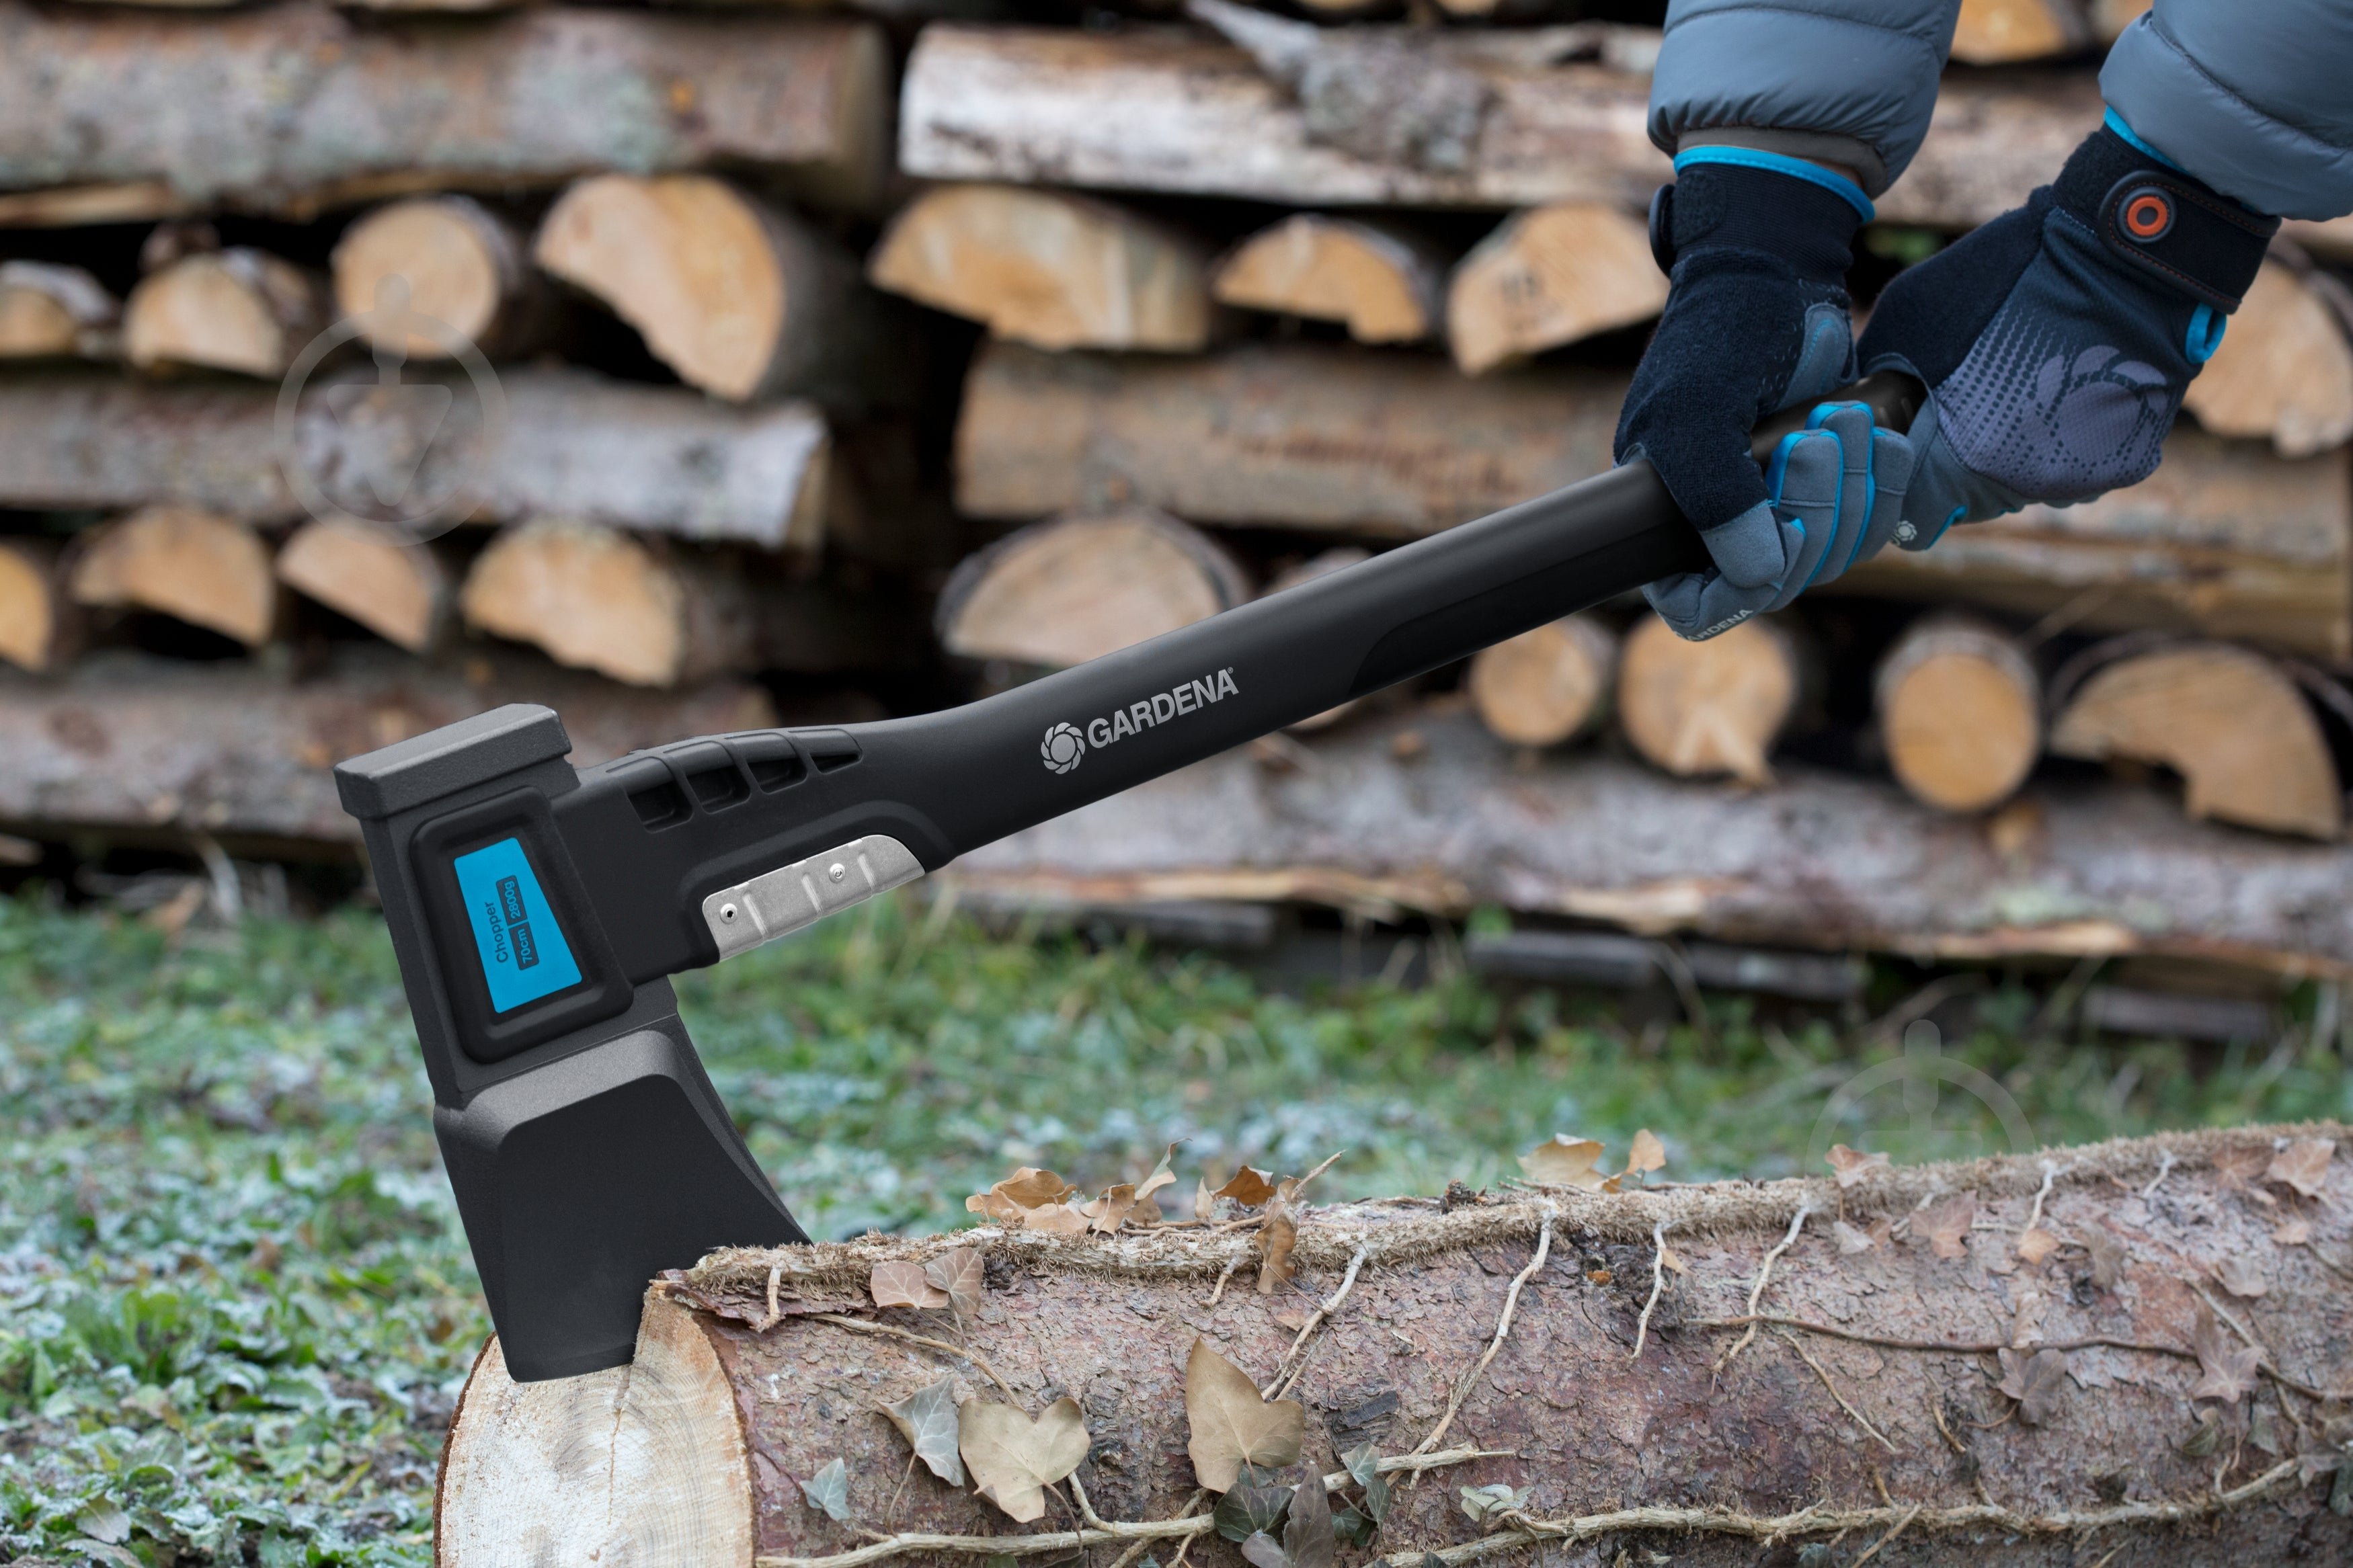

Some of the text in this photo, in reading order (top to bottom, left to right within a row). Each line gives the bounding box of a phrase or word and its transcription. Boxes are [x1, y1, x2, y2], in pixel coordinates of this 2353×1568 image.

[485, 902, 509, 963] Chopper
[504, 880, 532, 964] 70cm 2800g
